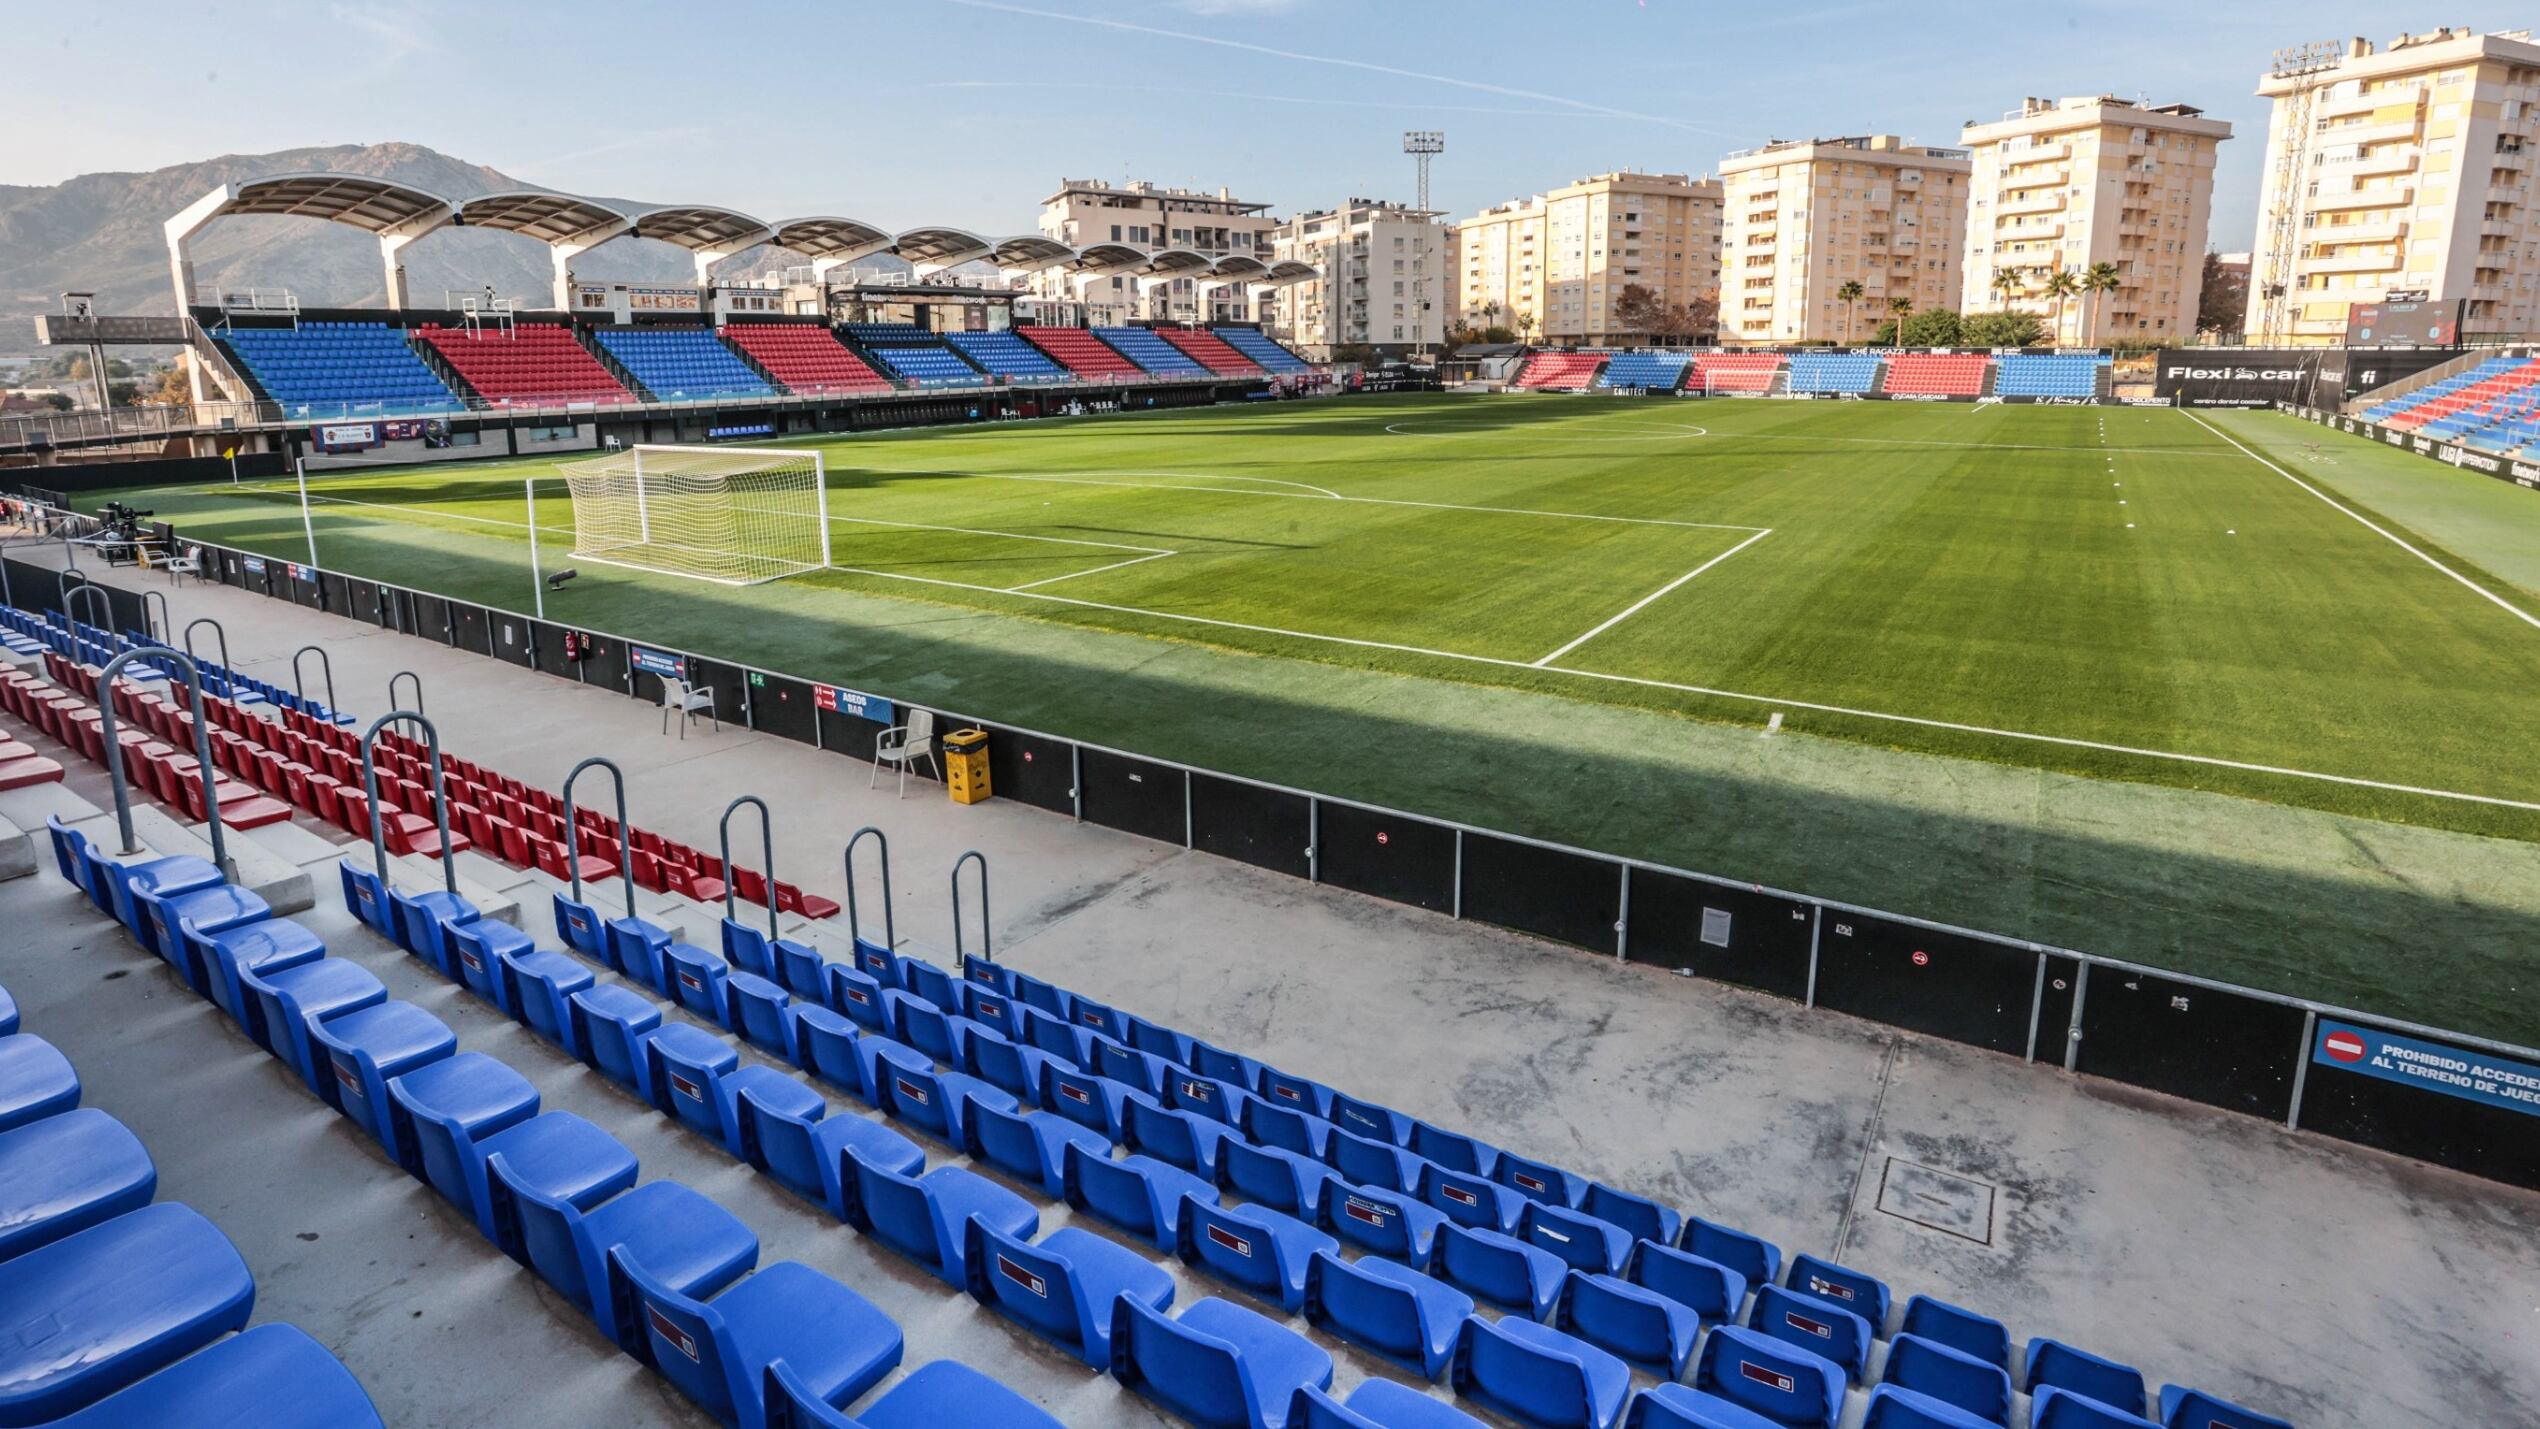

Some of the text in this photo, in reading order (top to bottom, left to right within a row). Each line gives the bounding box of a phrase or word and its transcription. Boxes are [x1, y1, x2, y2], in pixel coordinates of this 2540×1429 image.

[2168, 367, 2306, 380] Flexi car
[2361, 370, 2376, 384] fi
[842, 692, 867, 706] ASEOS
[847, 703, 864, 716] BAR
[2371, 1055, 2394, 1070] AL
[2397, 1061, 2473, 1088] TERRENO
[2474, 1079, 2498, 1094] DE
[2381, 1044, 2540, 1091] PROHIBIDO ACCEDE
